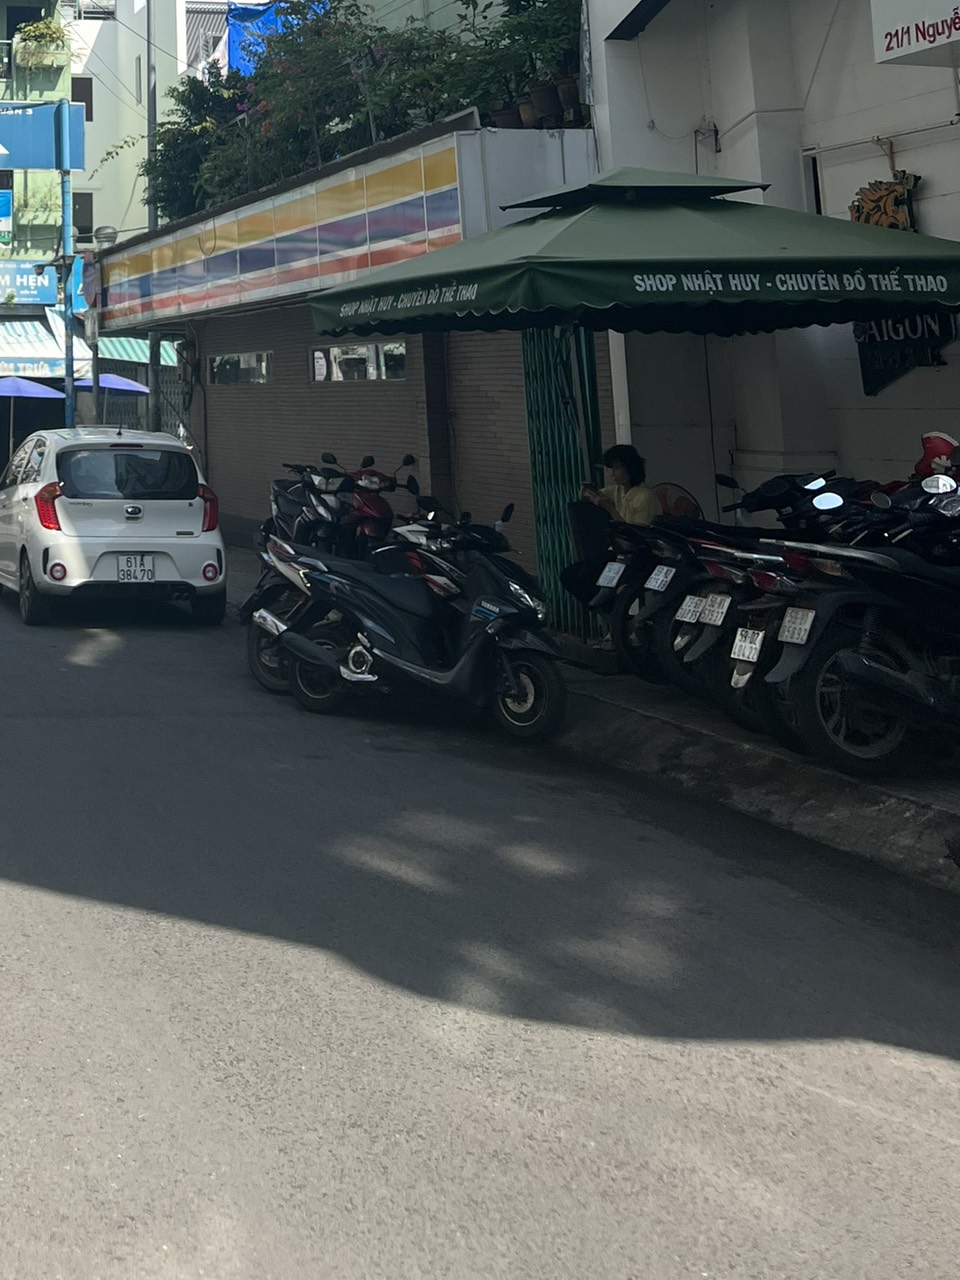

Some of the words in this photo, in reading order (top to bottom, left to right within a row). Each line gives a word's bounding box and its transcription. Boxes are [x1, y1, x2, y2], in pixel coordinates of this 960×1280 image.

[885, 26, 911, 52] 21/1
[25, 108, 33, 116] 3
[16, 274, 49, 289] HẸN
[633, 274, 677, 292] SHOP
[681, 270, 723, 295] NHẬT
[729, 274, 761, 291] HUY
[775, 269, 840, 291] CHUYÊN
[843, 267, 866, 291] ĐỒ
[868, 266, 902, 291] THỂ
[903, 274, 948, 293] THAO
[339, 301, 360, 317] SHOP
[358, 295, 379, 316] NHẬT
[377, 295, 394, 312] HUY
[397, 287, 429, 309] CHUYÊN
[427, 283, 440, 305] ĐỒ
[456, 283, 479, 301] THAO
[126, 556, 145, 568] 61A
